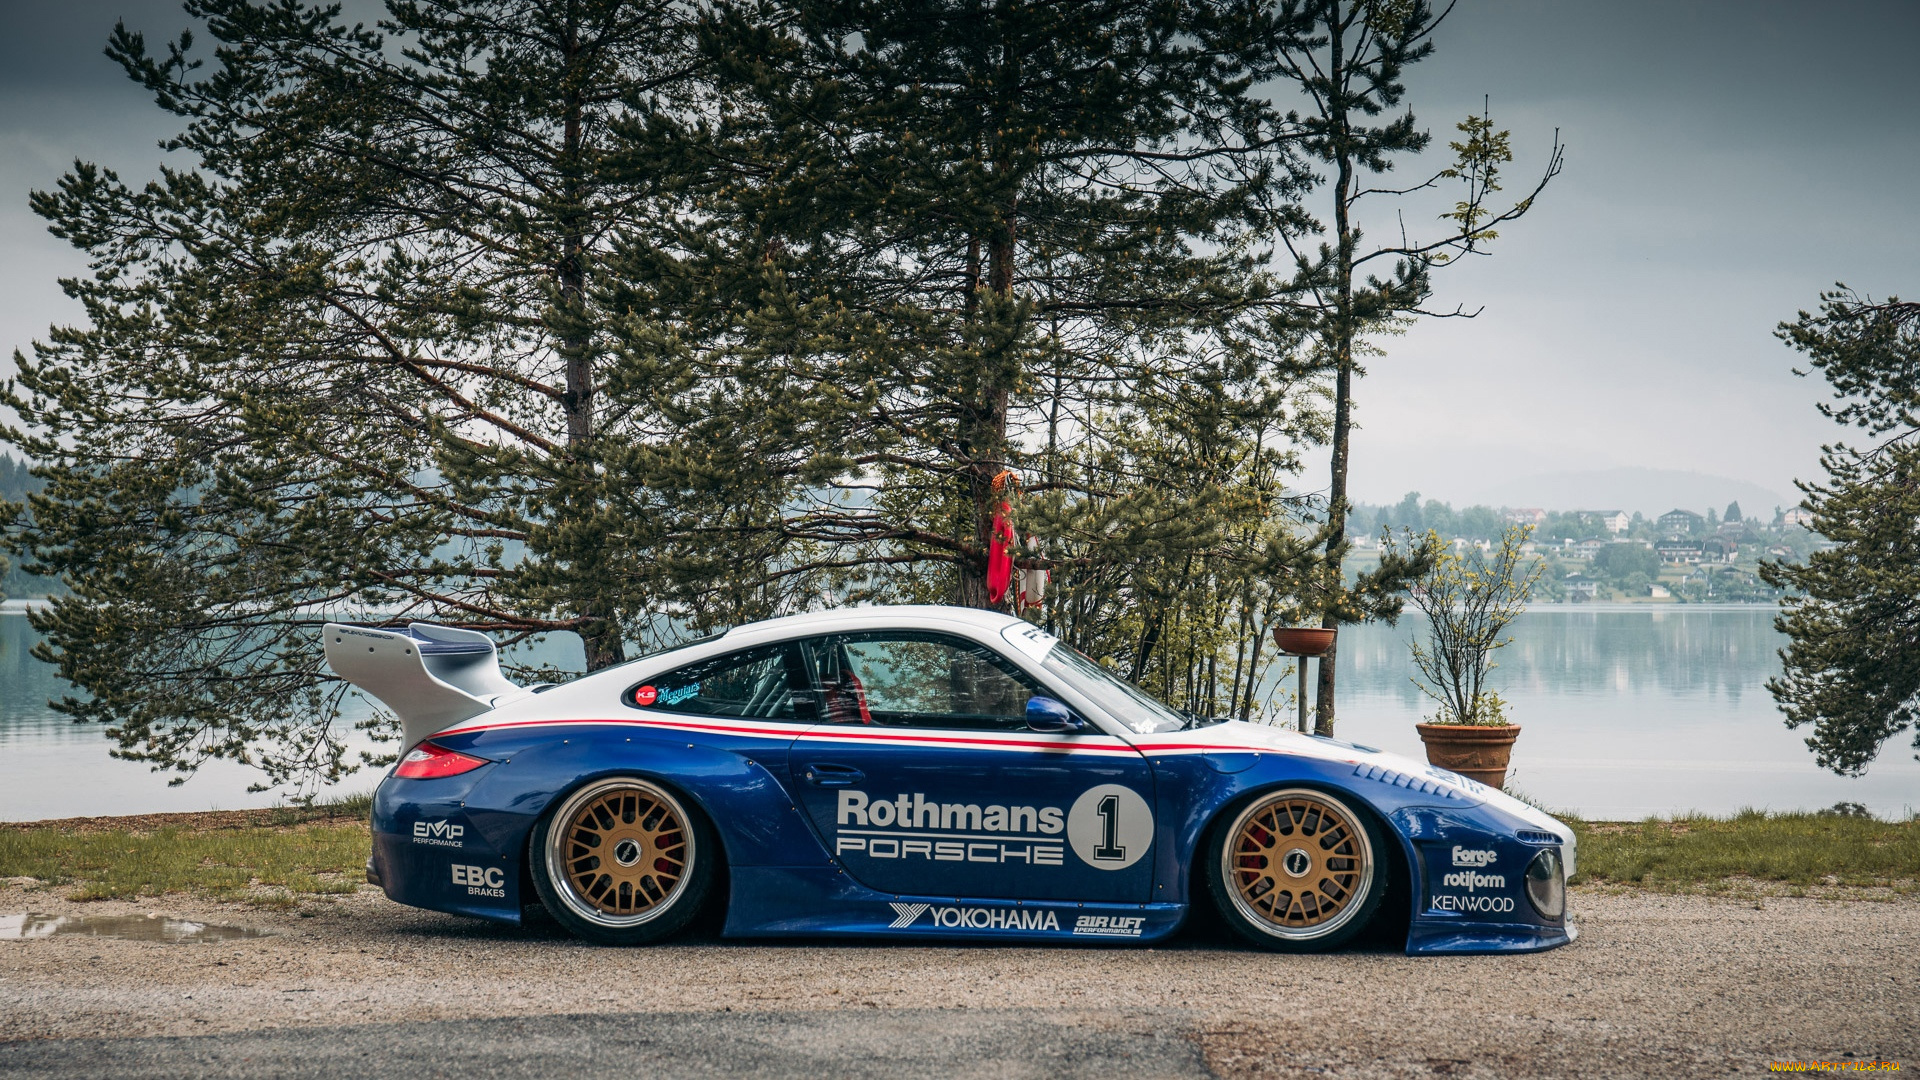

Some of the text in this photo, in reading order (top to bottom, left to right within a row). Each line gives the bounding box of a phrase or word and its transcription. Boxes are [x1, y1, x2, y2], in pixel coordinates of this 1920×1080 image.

[837, 789, 1065, 834] Rothmans
[413, 819, 464, 839] EMP
[1093, 795, 1126, 861] 1
[413, 837, 463, 848] PERFORMANCE
[836, 837, 1064, 866] PORSCHE
[451, 864, 505, 888] EBC
[1443, 871, 1506, 892] rotiform
[468, 886, 505, 898] BRAKES
[1432, 895, 1515, 912] KENWOOD
[930, 907, 1060, 931] YOKOHAMA
[1109, 916, 1146, 929] LIFT
